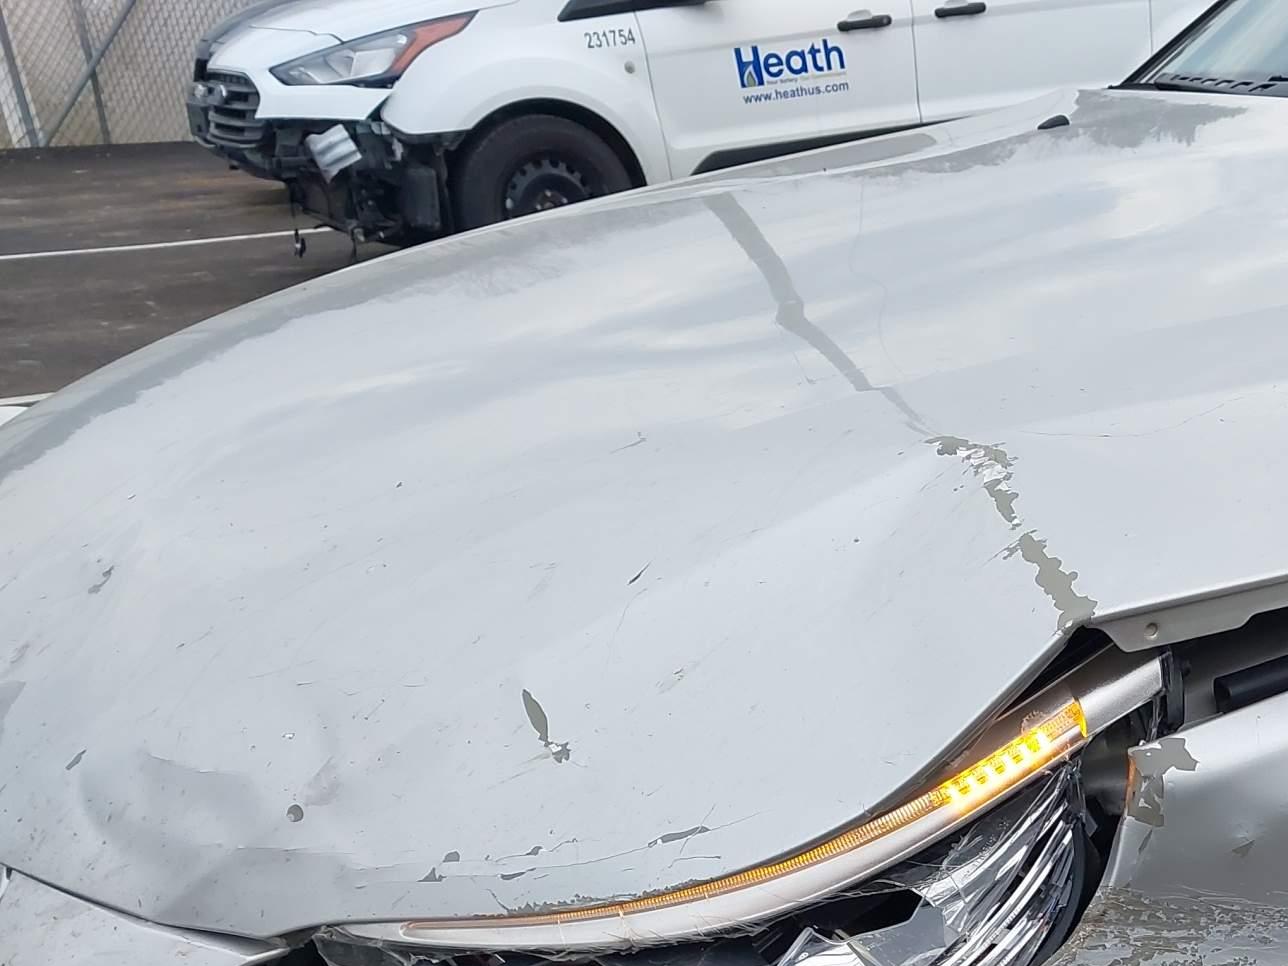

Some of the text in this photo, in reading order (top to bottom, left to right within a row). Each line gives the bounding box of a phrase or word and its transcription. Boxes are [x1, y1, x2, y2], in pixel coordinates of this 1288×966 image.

[583, 28, 635, 49] 231754
[734, 39, 846, 89] Heath
[743, 82, 849, 104] www.heathus.com
